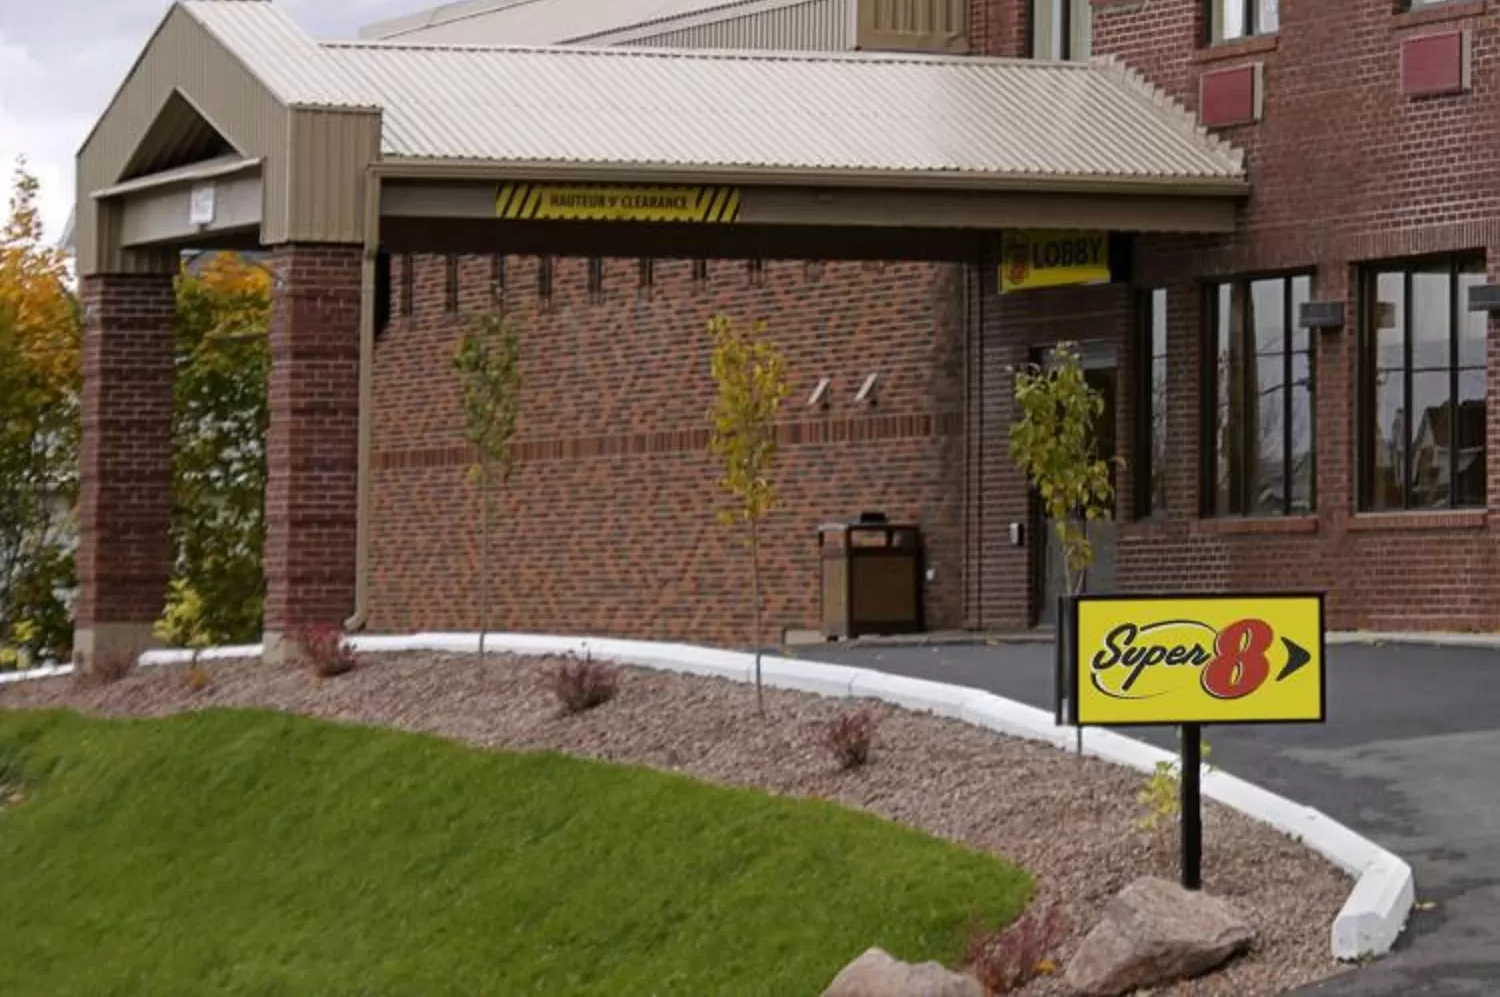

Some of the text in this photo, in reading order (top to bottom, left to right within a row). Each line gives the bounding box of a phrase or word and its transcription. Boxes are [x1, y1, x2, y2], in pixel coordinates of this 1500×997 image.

[621, 194, 688, 210] CLEARANCE
[1032, 236, 1104, 270] LOBBY
[1091, 617, 1275, 700] Super 8
